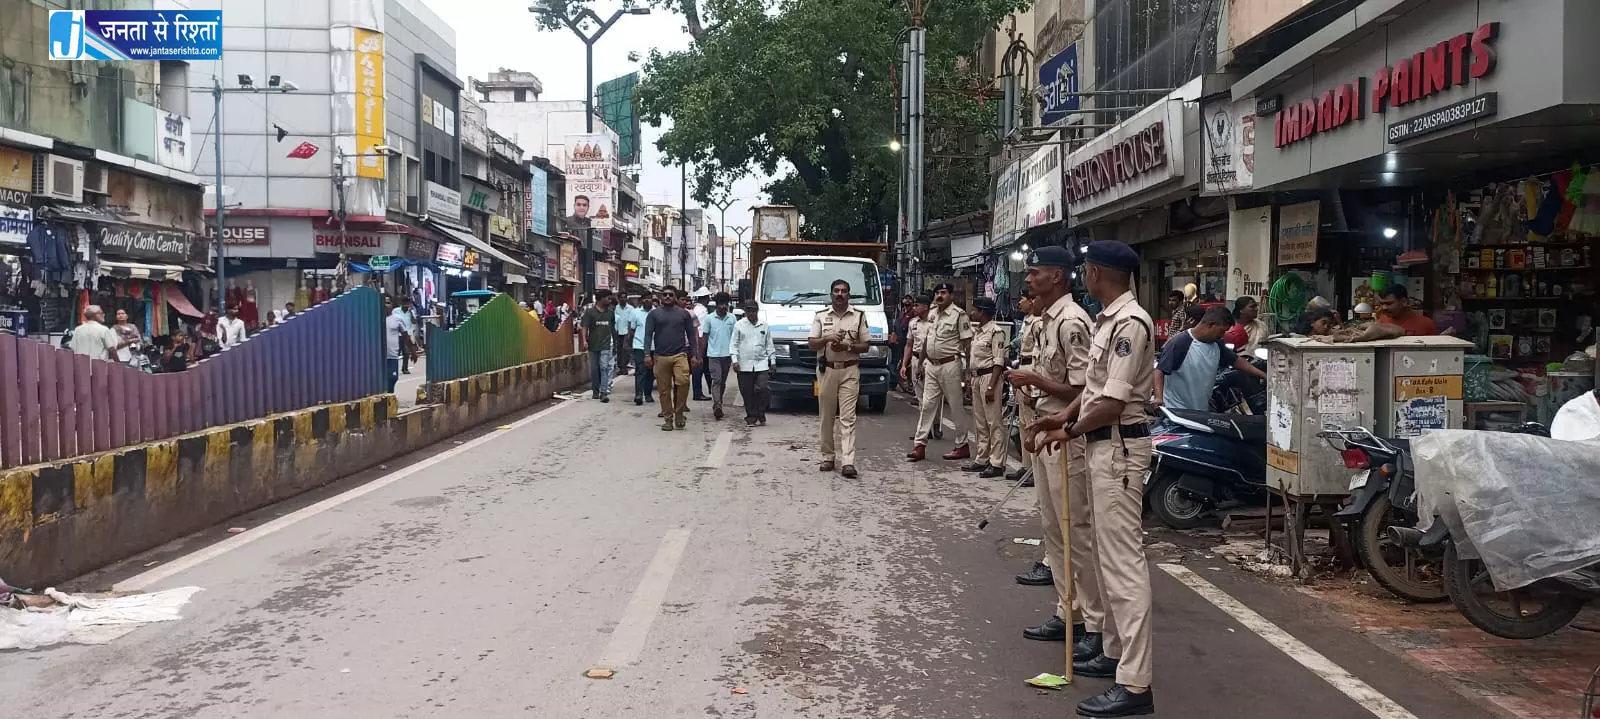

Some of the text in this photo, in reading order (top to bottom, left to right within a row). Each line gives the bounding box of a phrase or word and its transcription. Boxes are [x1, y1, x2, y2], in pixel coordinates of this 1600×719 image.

[1275, 79, 1362, 149] IMDADI
[1373, 23, 1493, 113] PAINTS
[1389, 121, 1409, 140] GSTIN
[1064, 152, 1113, 205] FASHION
[1113, 123, 1163, 185] HOUSE
[100, 227, 134, 253] Quality
[134, 231, 156, 250] Cloth
[156, 235, 184, 254] Centre
[316, 235, 381, 248] BHANSALI
[1243, 281, 1263, 297] FIXIT
